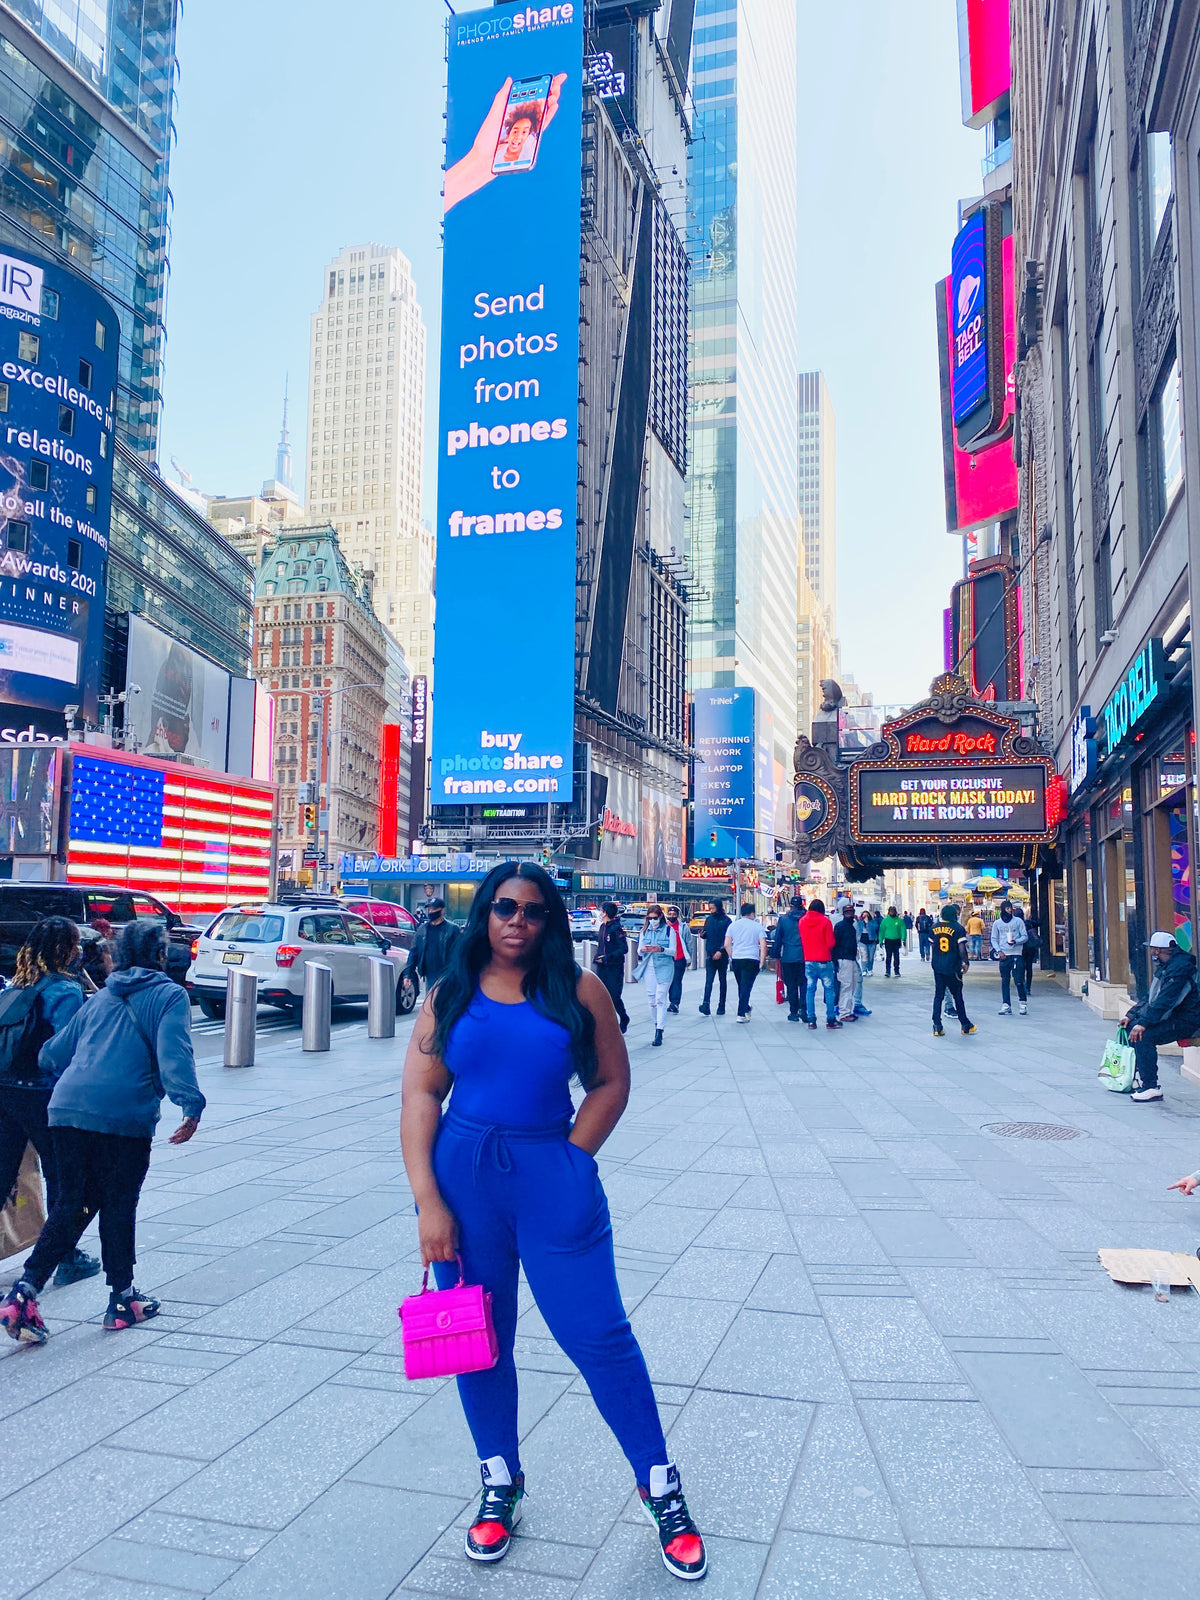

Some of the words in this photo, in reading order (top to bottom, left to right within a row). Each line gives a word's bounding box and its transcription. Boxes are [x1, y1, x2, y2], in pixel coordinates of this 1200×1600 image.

[457, 3, 574, 40] PHOTOshare
[457, 36, 484, 46] FRIENDS
[487, 33, 500, 41] AND
[502, 28, 525, 37] FAMILY
[527, 23, 549, 32] SMART
[552, 18, 574, 27] FRAME
[2, 264, 33, 302] IR
[473, 284, 544, 318] Send
[956, 315, 981, 351] TACO
[460, 332, 558, 369] photos
[958, 333, 982, 368] BELL
[2, 361, 103, 421] excellence
[105, 407, 113, 432] in
[474, 377, 540, 404] from
[447, 418, 567, 455] phones
[6, 427, 92, 475] relations
[491, 466, 520, 489] to
[24, 500, 45, 519] all
[50, 506, 73, 529] the
[448, 508, 563, 537] frames
[1, 551, 66, 583] Awards
[71, 571, 96, 597] 2021
[709, 697, 733, 705] TriNet
[1104, 681, 1128, 755] TACO
[1128, 637, 1158, 727] BELL
[481, 731, 522, 751] buy
[699, 736, 750, 745] RETURNING
[700, 748, 711, 756] TO
[713, 748, 742, 756] WORK
[906, 733, 952, 753] Hard
[953, 732, 997, 755] Rock
[441, 752, 563, 775] photoshare
[708, 765, 743, 773] LAPTOP
[443, 776, 558, 794] frame.com
[708, 781, 731, 789] KEYS
[901, 779, 919, 791] GET
[921, 779, 948, 790] YOUR
[950, 777, 1003, 790] EXCLUSIVE
[708, 797, 745, 806] HAZMAT
[872, 792, 908, 806] HARD
[910, 791, 947, 805] ROCK
[950, 791, 987, 804] MASK
[989, 790, 1036, 804] TODAY!
[708, 807, 733, 815] SUIT?
[892, 806, 909, 820] AT
[911, 806, 936, 820] THE
[938, 805, 975, 820] ROCK
[977, 805, 1014, 819] SHOP
[409, 854, 452, 873] POLICE
[457, 853, 490, 873] DEPT
[688, 864, 730, 876] Subwa
[939, 936, 950, 953] 8
